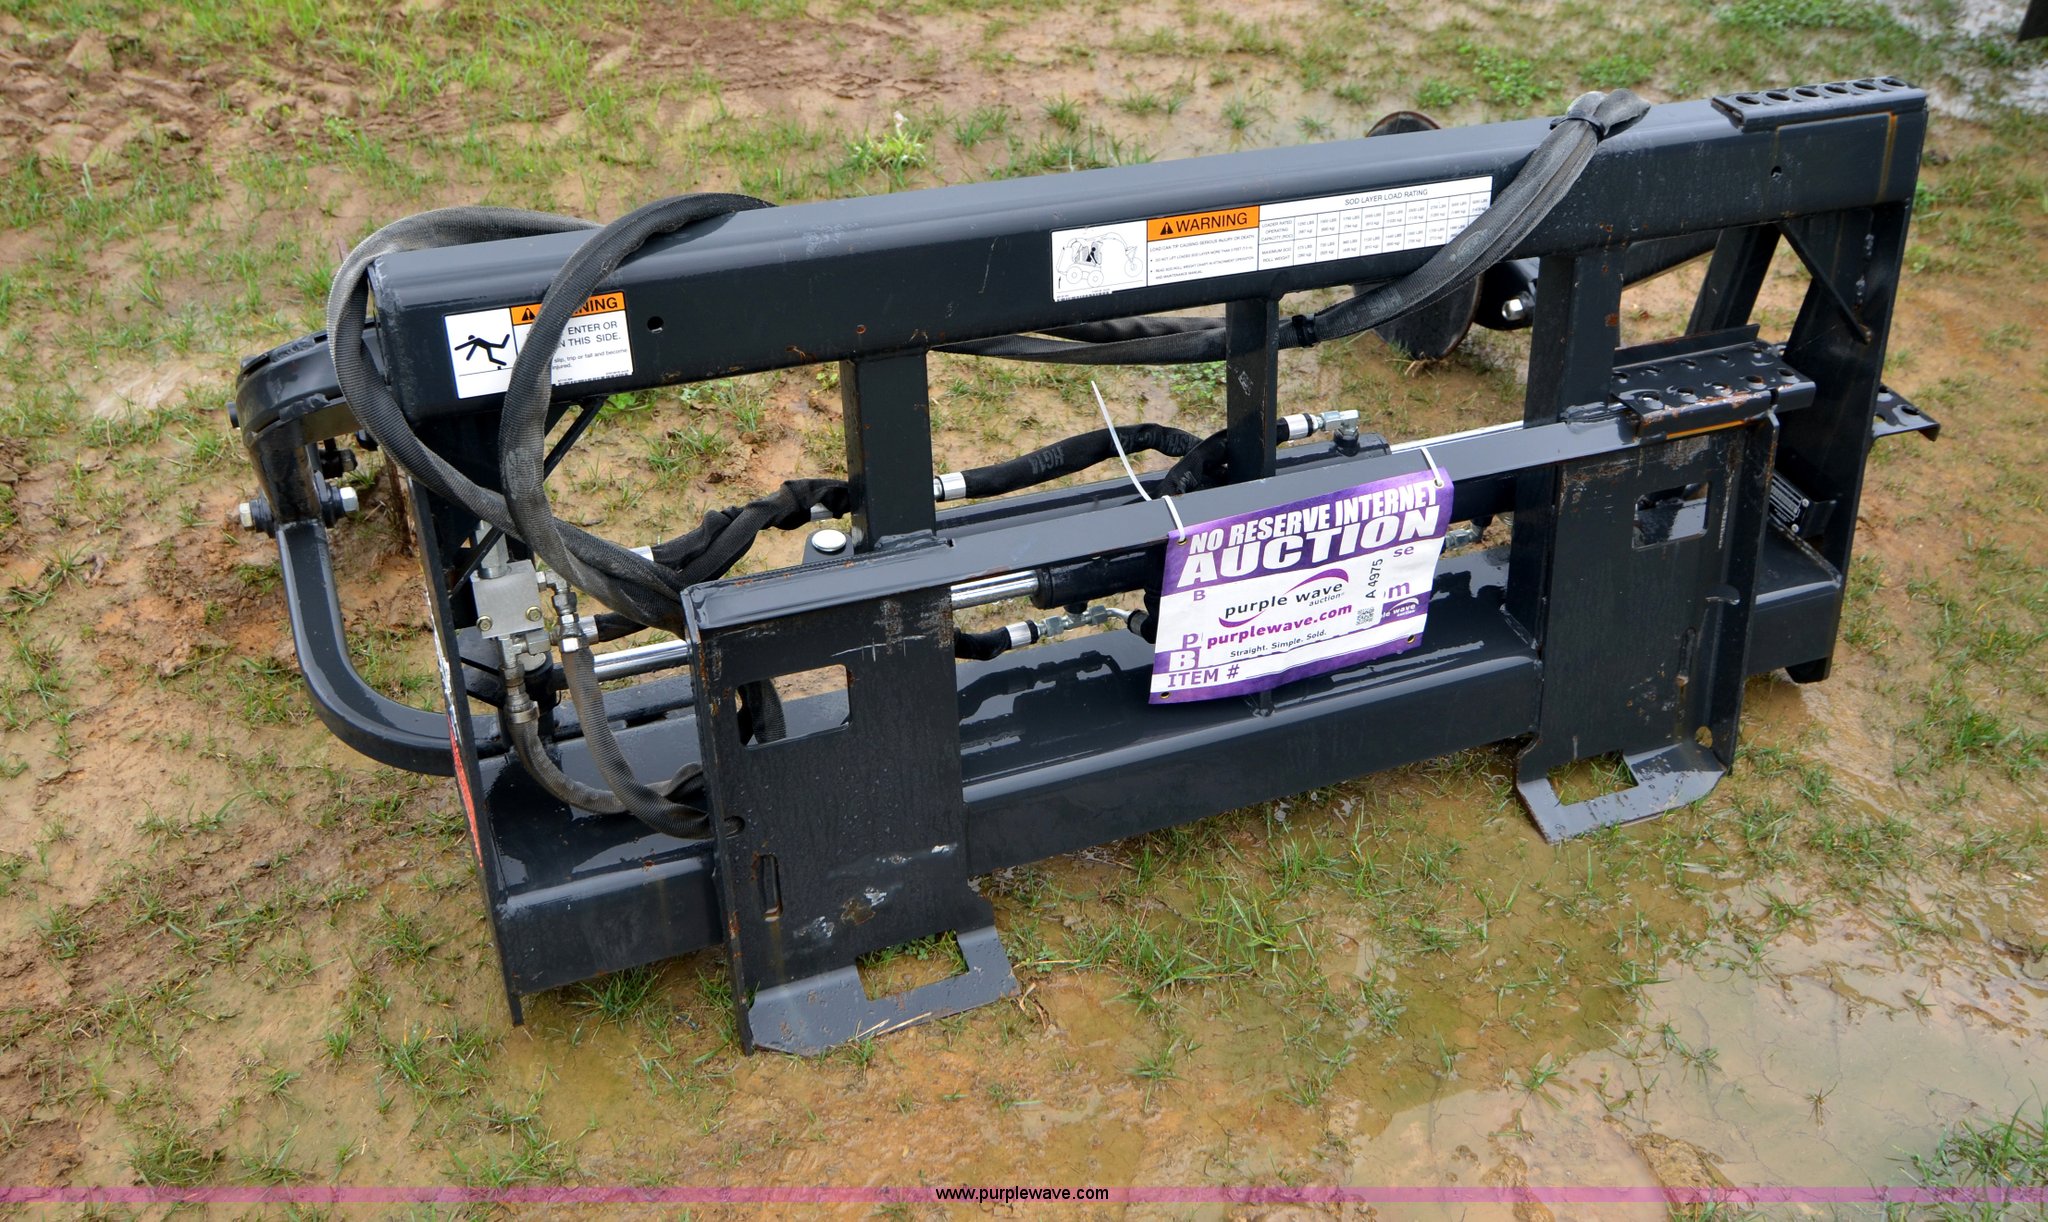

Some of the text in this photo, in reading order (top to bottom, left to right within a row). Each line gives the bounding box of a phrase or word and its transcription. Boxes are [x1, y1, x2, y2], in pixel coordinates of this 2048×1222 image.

[1345, 189, 1428, 205] SOD LAYER LOAD RATING
[1176, 212, 1248, 233] WARNING
[575, 297, 617, 314] NING
[568, 321, 617, 335] ENTER OR
[568, 336, 591, 346] THIS
[596, 332, 621, 343] SIDE.
[1189, 480, 1437, 555] NO RESERVE INTERNET
[1177, 505, 1440, 588] AUCTION
[1366, 558, 1383, 598] A 4975
[1224, 583, 1343, 619] purple wave
[1308, 593, 1341, 607] auction
[1206, 604, 1352, 650] purplewave.com
[1230, 629, 1327, 658] Straight. Simple. Sold.
[1167, 663, 1240, 688] ITEM #
